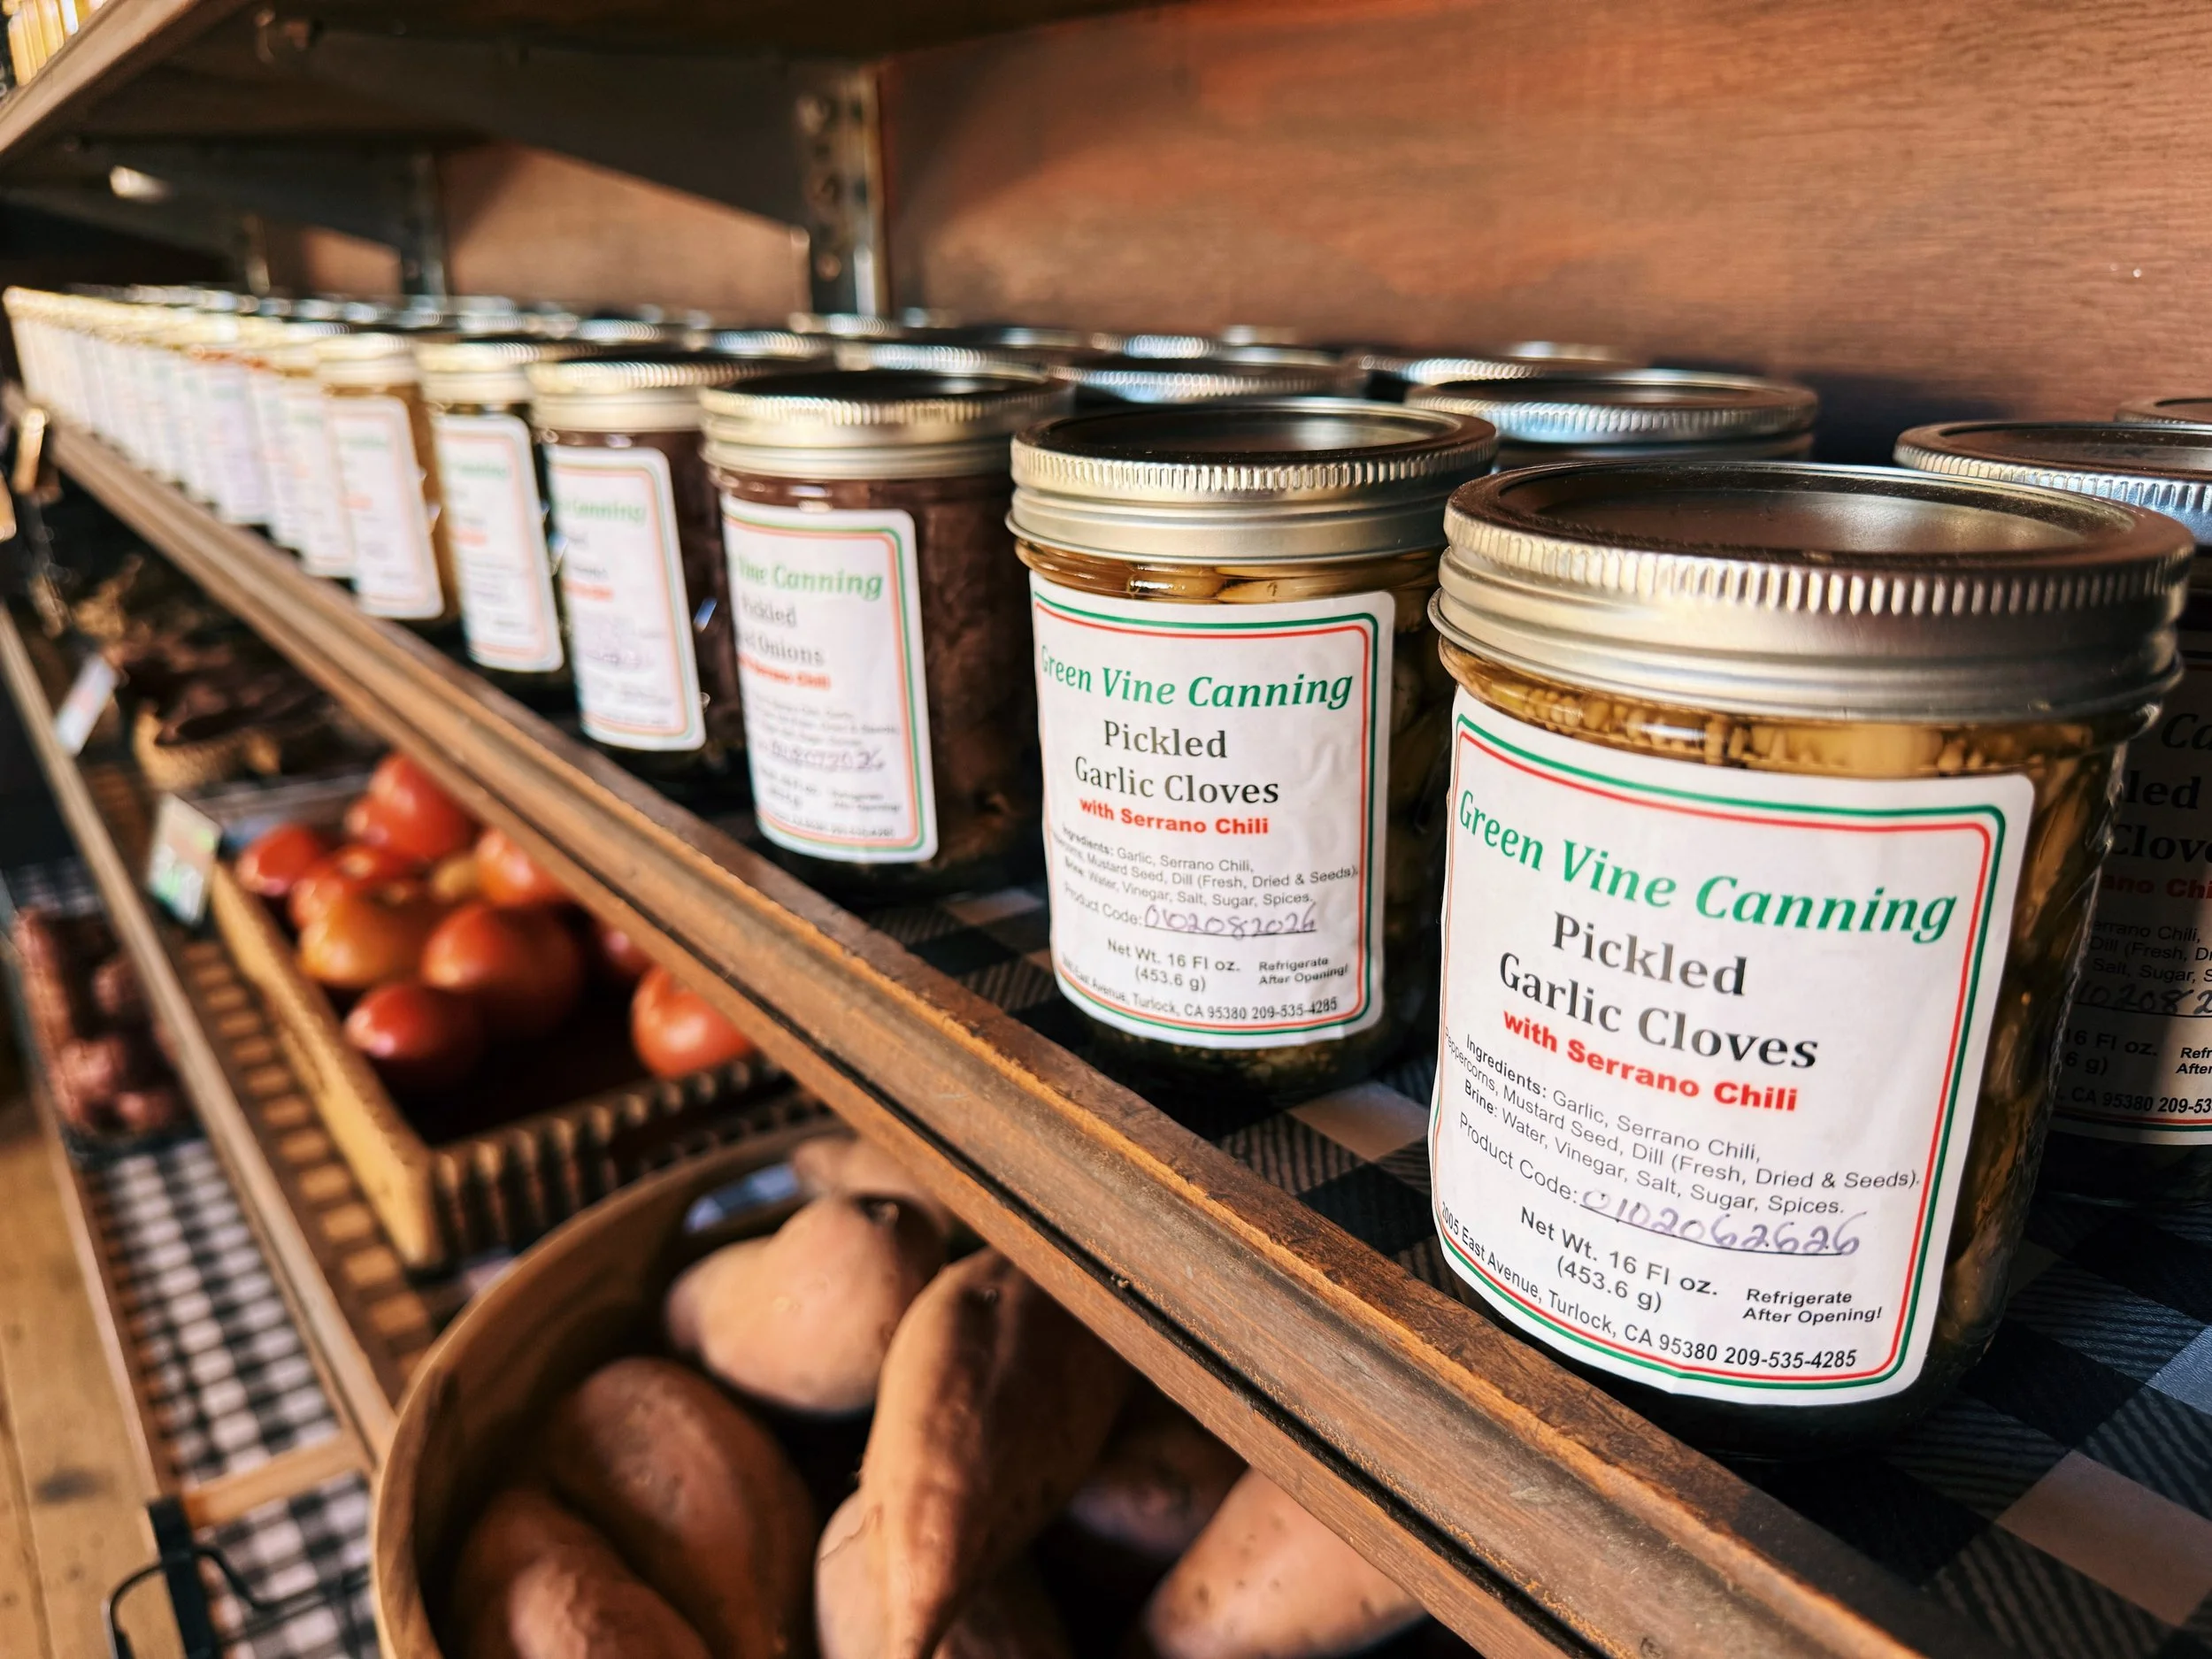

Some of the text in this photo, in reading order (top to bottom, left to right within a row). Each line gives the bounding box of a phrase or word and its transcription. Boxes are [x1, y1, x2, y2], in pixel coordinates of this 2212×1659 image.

[774, 564, 884, 602] Canning
[1041, 645, 1354, 710] Green Vine Canning
[1104, 719, 1228, 758] Pickled
[1075, 757, 1279, 803] Garlic Cloves
[1079, 798, 1269, 834] with Serrano Chili
[1117, 847, 1156, 867] Garlic,
[1160, 855, 1214, 871] Serrano
[1218, 859, 1254, 873] Chili,
[2110, 824, 2212, 863] Clov
[1132, 867, 1168, 884] Seed,
[1172, 872, 1193, 885] Dill
[1197, 874, 1248, 889] (Fresh,
[1252, 875, 1289, 888] Dried
[1294, 873, 1305, 886] &
[1459, 789, 1958, 944] Green Vine Canning
[1122, 881, 1173, 902] Vinegar,
[1177, 891, 1207, 906] Salt,
[1212, 894, 1257, 909] Sugar,
[1263, 893, 1314, 908] Spices.
[1102, 902, 1143, 926] Code:
[2093, 919, 2200, 943] errano Chili,
[1108, 938, 1240, 972] Net Wt. 16 Fl oz.
[1258, 956, 1329, 972] Refrigerate
[1552, 910, 1747, 997] Pickled
[2124, 941, 2187, 961] (Fresh,
[1135, 964, 1206, 992] (453.6 g)
[1258, 974, 1290, 985] After
[2093, 957, 2131, 978] Salt,
[2140, 964, 2196, 984] Sugar,
[1184, 1002, 1203, 1017] CA
[1207, 1005, 1246, 1019] 95380
[1252, 996, 1338, 1019] 209-535-4285
[1500, 951, 1819, 1069] Garlic Cloves
[1502, 1010, 1799, 1112] with Serrano Chili
[2125, 1041, 2157, 1056] oz.
[1445, 1026, 1921, 1189] Peppercorns, Mustard Seed, Dill (Fresh, Dried & Seeds).
[1466, 1033, 1761, 1163] Ingredients: Garlic, Serrano Chili,
[2071, 1087, 2096, 1102] CA
[2102, 1091, 2154, 1112] 95380
[1459, 1111, 1578, 1204] Product Code:
[1464, 1079, 1845, 1216] Brine: Water, Vinegar, Salt, Sugar, Spices.
[1521, 1205, 1718, 1295] Net Wt. 16 Fl oz.
[1441, 1201, 1858, 1370] 2005 East Avenue, Turlock, CA 95380 209-535-4285
[1557, 1256, 1663, 1314] (453.6 g)
[1746, 1288, 1852, 1309] Refrigerate
[1742, 1306, 1883, 1326] After Opening!
